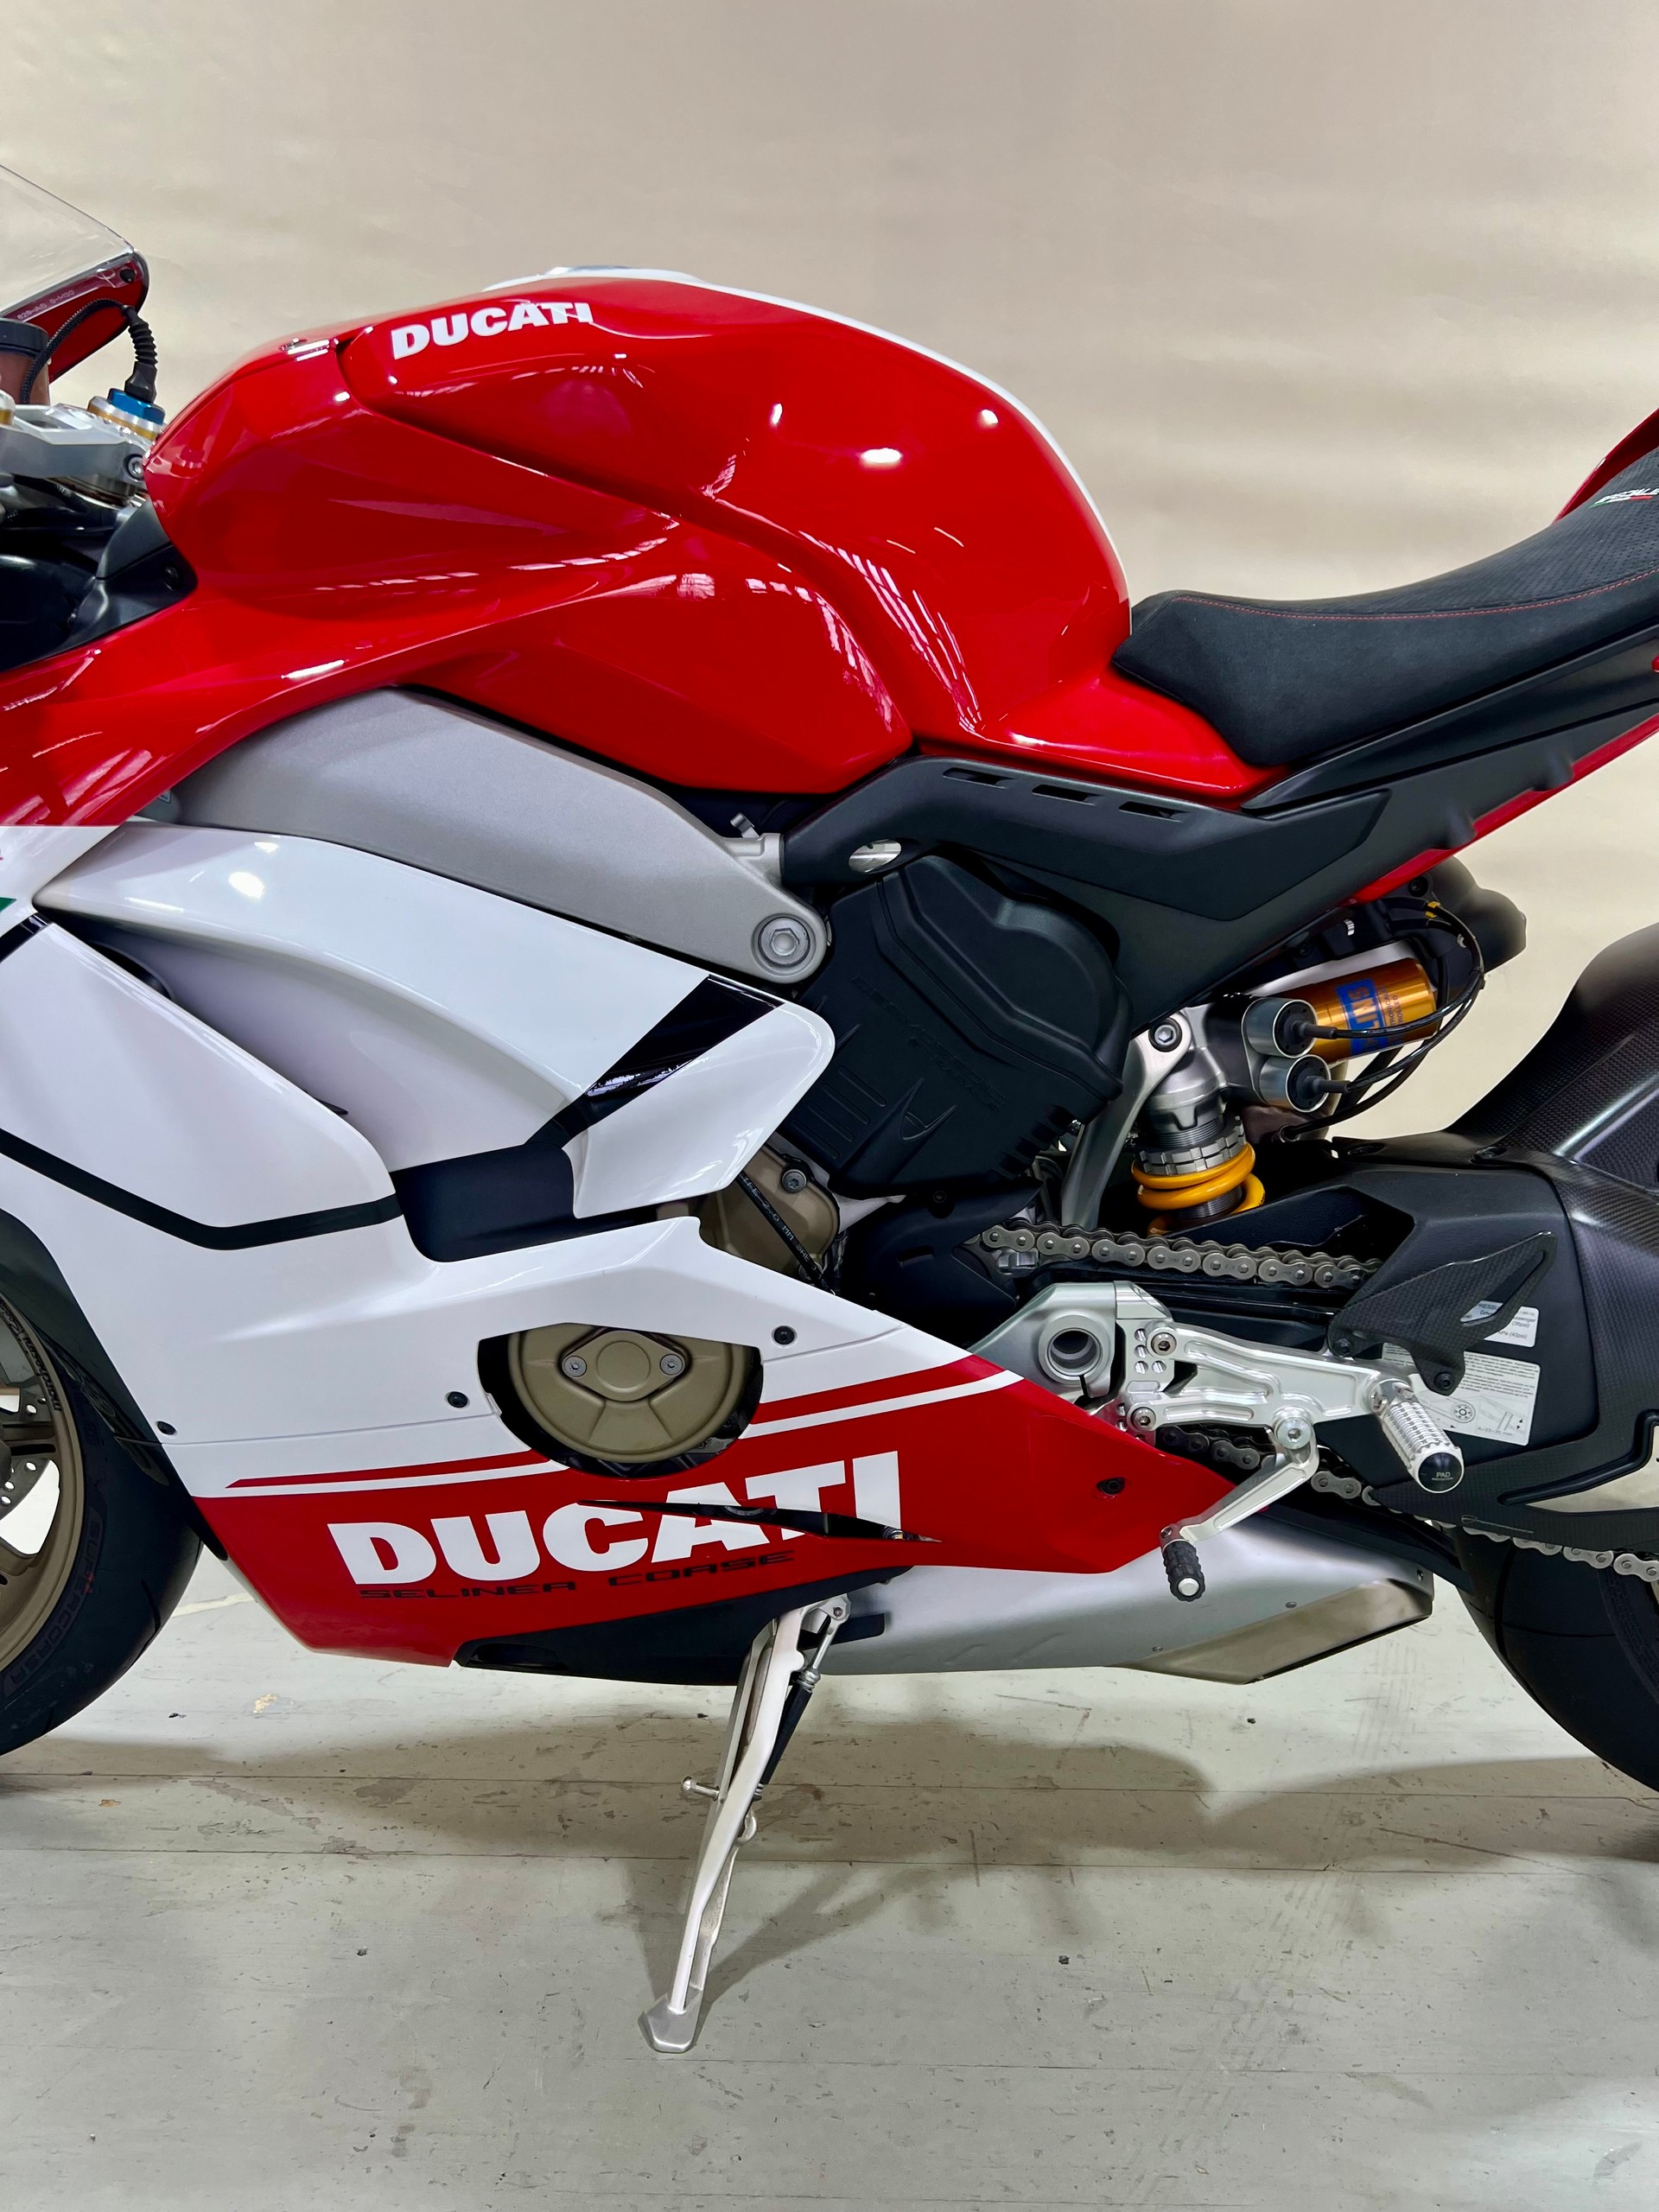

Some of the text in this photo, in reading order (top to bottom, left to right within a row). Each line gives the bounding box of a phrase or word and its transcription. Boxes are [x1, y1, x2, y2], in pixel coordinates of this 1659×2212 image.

[391, 302, 594, 360] DUCATI
[327, 1451, 901, 1585] DUCATI
[607, 1549, 795, 1587] CORSE
